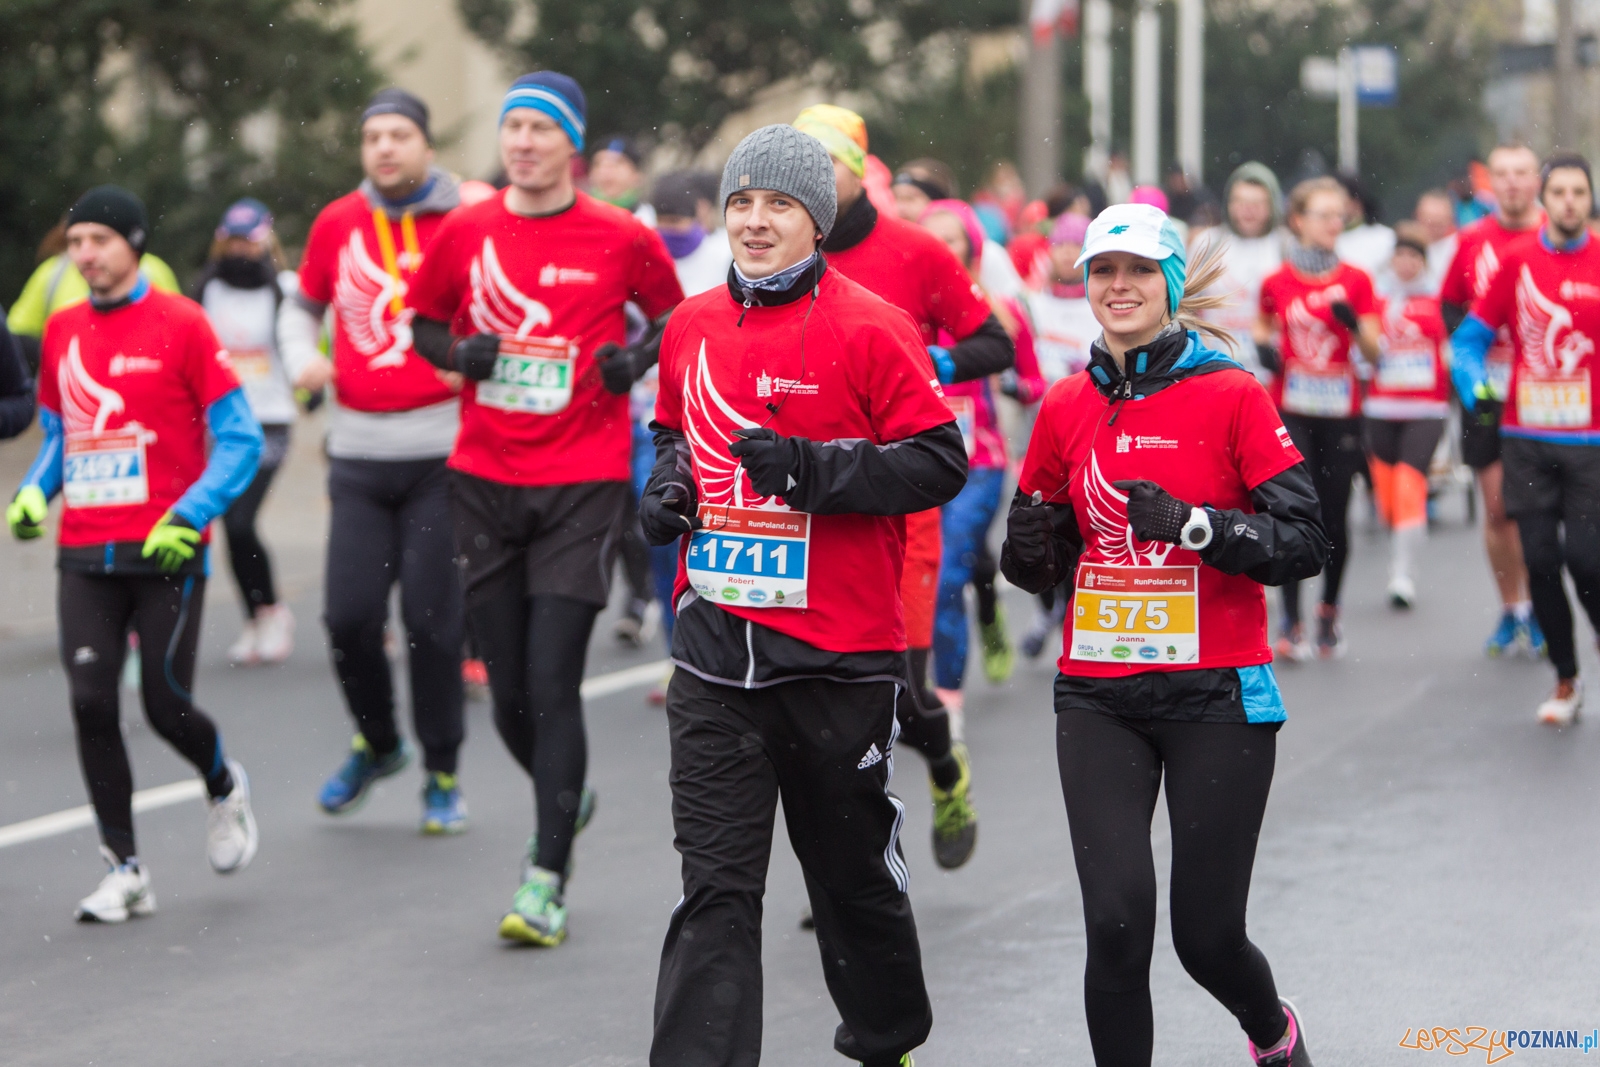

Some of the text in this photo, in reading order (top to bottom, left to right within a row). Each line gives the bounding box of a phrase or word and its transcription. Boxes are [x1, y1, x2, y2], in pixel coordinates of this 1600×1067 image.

[1107, 225, 1130, 235] 4F
[748, 521, 799, 532] RunPoland.org
[690, 538, 788, 575] E 1711
[728, 576, 755, 586] Robert
[1077, 598, 1170, 631] D 575
[1115, 635, 1146, 643] Joanna
[857, 753, 883, 770] adidas
